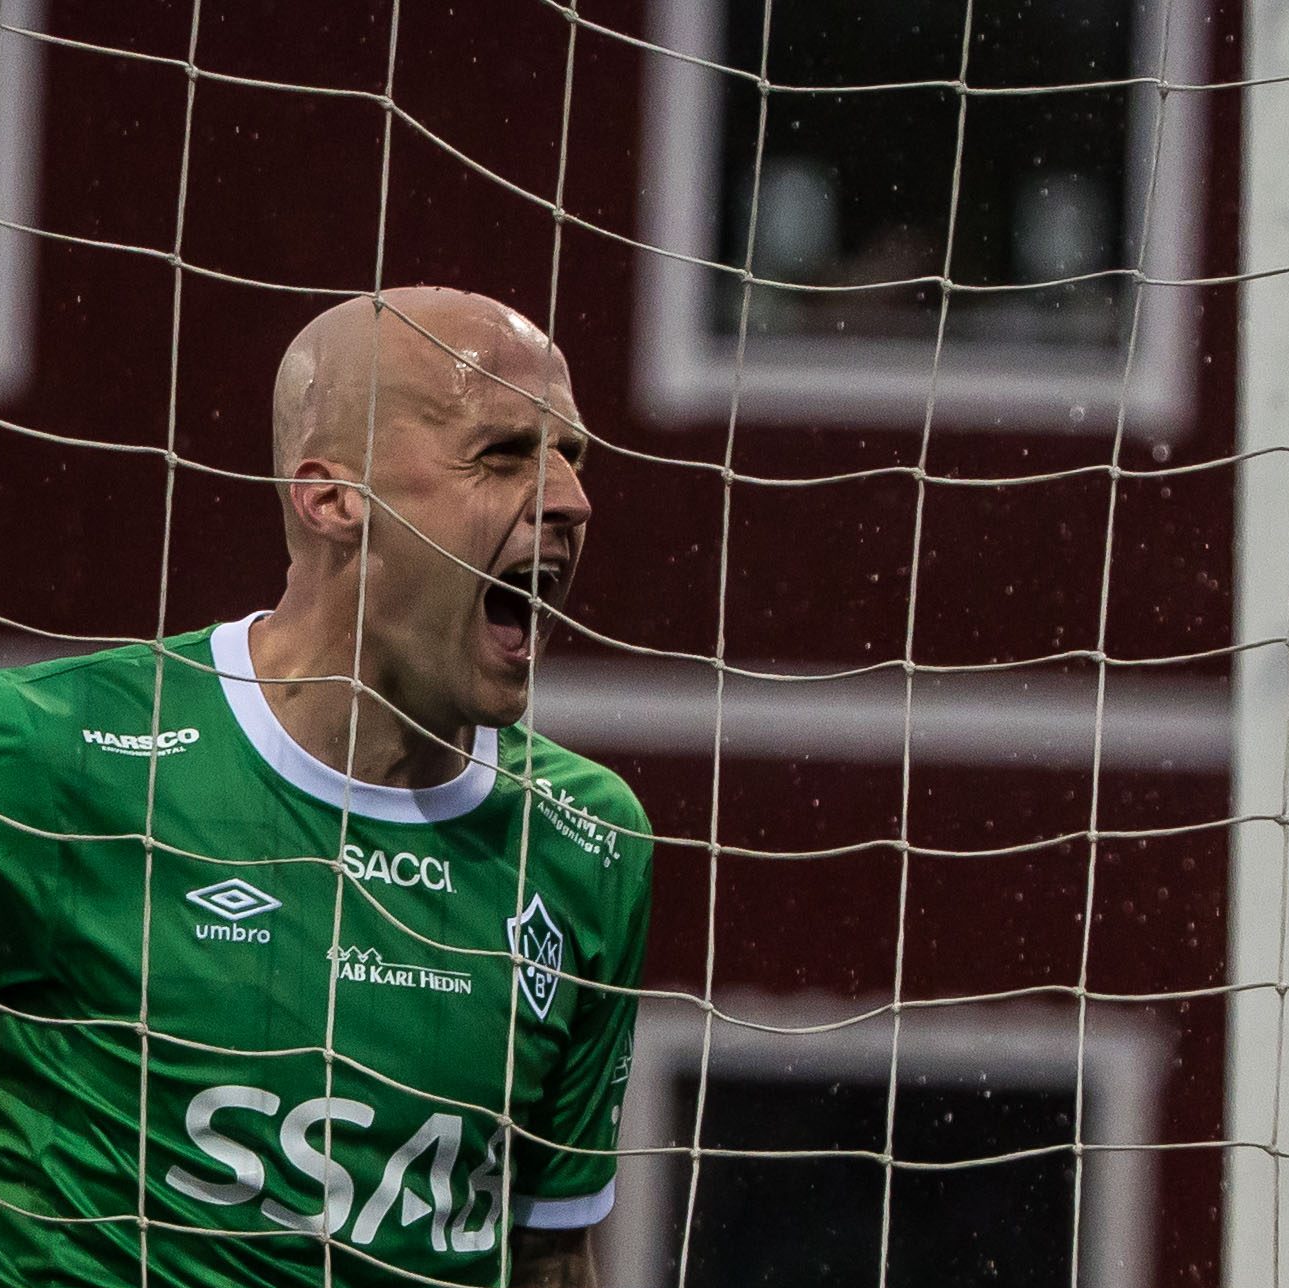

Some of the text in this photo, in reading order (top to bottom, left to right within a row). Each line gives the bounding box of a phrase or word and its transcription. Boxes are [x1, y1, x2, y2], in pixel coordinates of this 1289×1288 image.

[82, 728, 200, 750] HARSCO
[343, 844, 453, 893] SACCI
[196, 922, 271, 944] umbro
[340, 962, 472, 995] AB KARL HEDIN
[165, 1084, 508, 1252] SSAB
